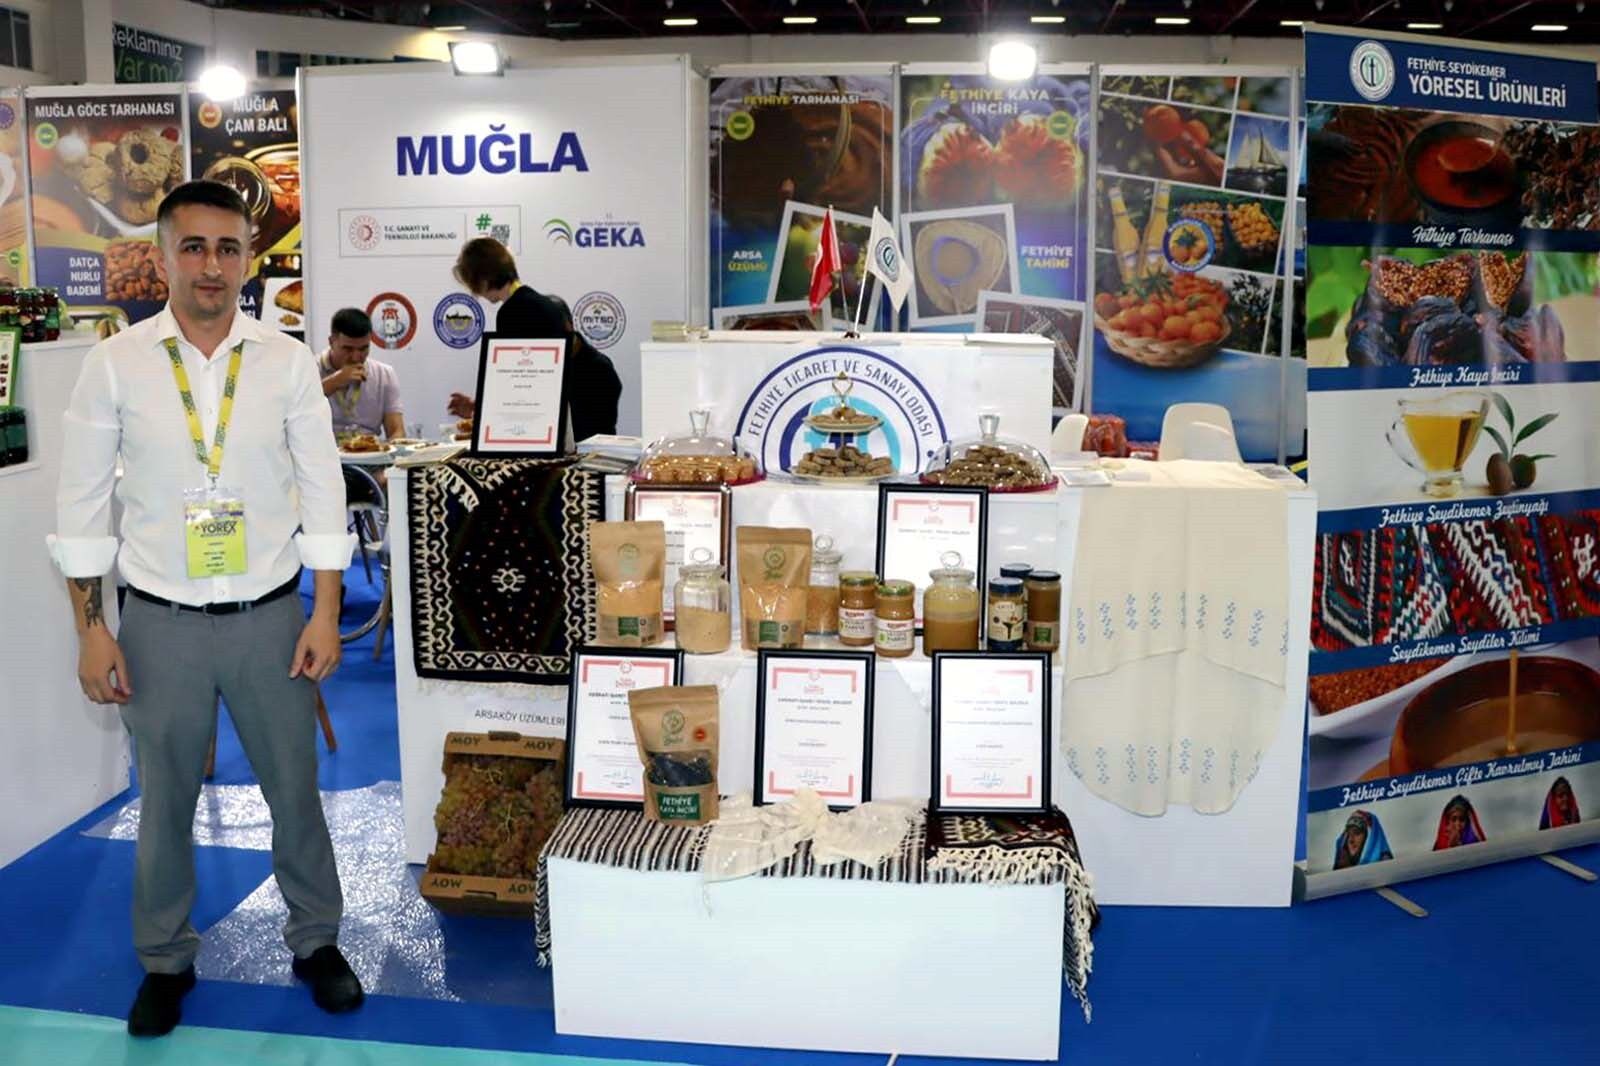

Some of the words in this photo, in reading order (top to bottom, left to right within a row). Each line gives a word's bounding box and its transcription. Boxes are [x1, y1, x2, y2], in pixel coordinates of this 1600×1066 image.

[1008, 87, 1050, 101] KAYA
[1408, 70, 1485, 101] YÖRESEL
[1488, 77, 1567, 108] ÜRÜNLERİ
[34, 102, 75, 118] MUĞLA
[77, 101, 108, 117] GÖCE
[110, 102, 175, 116] TARHANASI
[971, 100, 1019, 115] İNCİRİ
[225, 119, 255, 136] ÇAM
[257, 118, 287, 133] BALI
[396, 123, 589, 176] MUĞLA
[574, 227, 646, 248] GEKA
[1412, 226, 1457, 248] Fethiye
[1457, 227, 1514, 246] Tarhanası
[732, 249, 763, 260] ARSA
[1021, 244, 1074, 257] FETHİYE
[69, 257, 100, 270] DATÇA
[70, 271, 101, 282] NURLU
[66, 284, 101, 296] BADEMİ
[1409, 367, 1454, 387] Fethiye
[1456, 366, 1489, 387] Kaya
[844, 359, 860, 374] VE
[905, 396, 934, 437] ODASI
[1378, 508, 1424, 529] Fethiye
[1427, 502, 1492, 524] Seydikemer
[1389, 643, 1456, 663] Seydikemer
[1459, 634, 1506, 655] Seydiler
[450, 736, 481, 746] MOY
[523, 740, 556, 750] MOY
[1339, 786, 1385, 808] Fethiye
[1387, 776, 1453, 798] Seydikemer
[1455, 767, 1484, 788] Çifte
